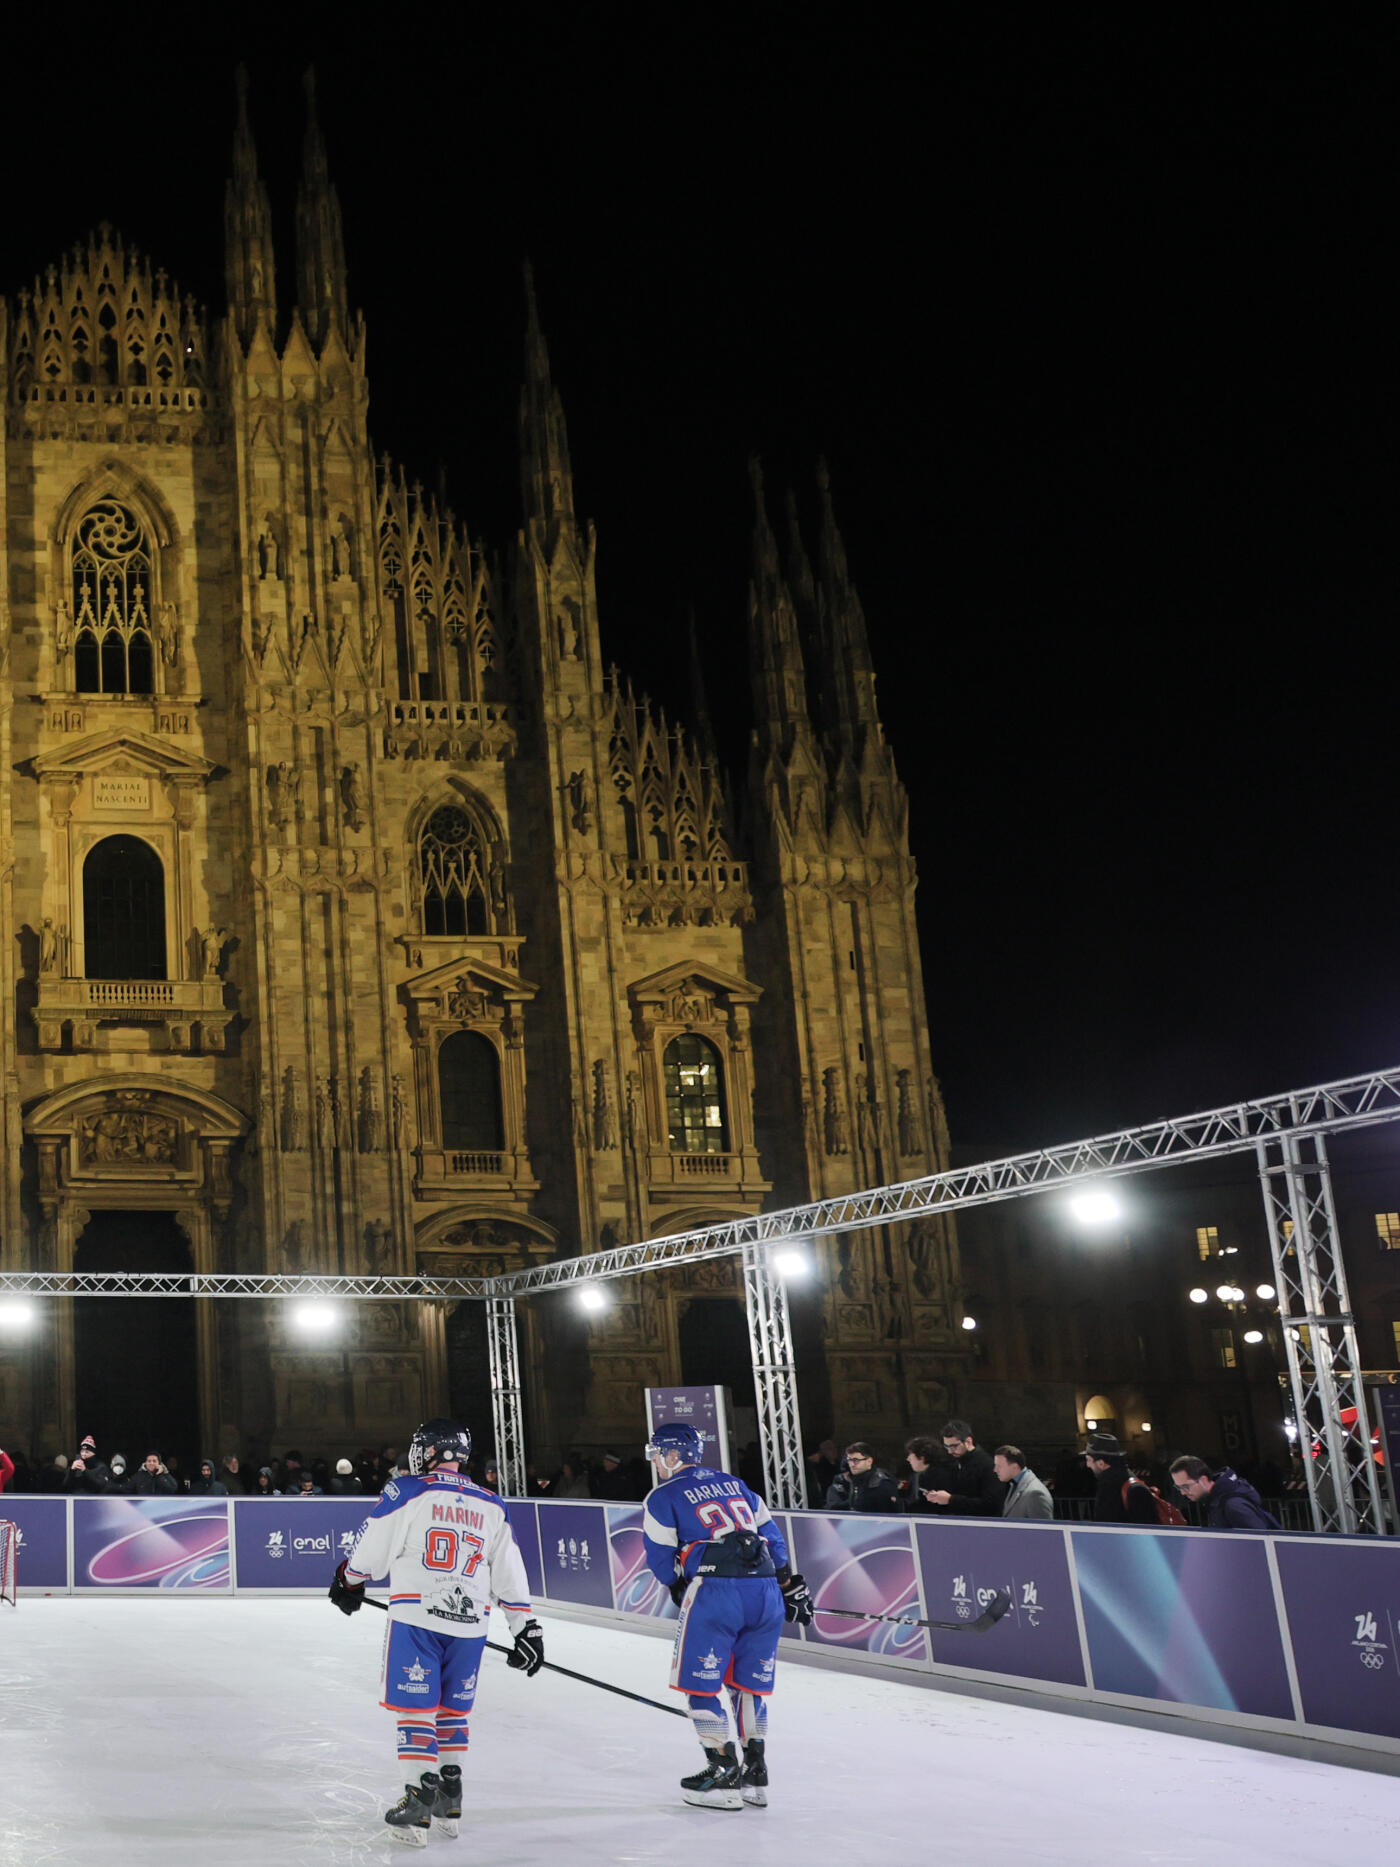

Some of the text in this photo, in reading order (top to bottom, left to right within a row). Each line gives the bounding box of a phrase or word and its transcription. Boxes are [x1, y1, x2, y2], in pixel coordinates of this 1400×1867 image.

[432, 1504, 484, 1530] MARINI
[293, 1534, 331, 1550] enel
[422, 1527, 485, 1578] 07
